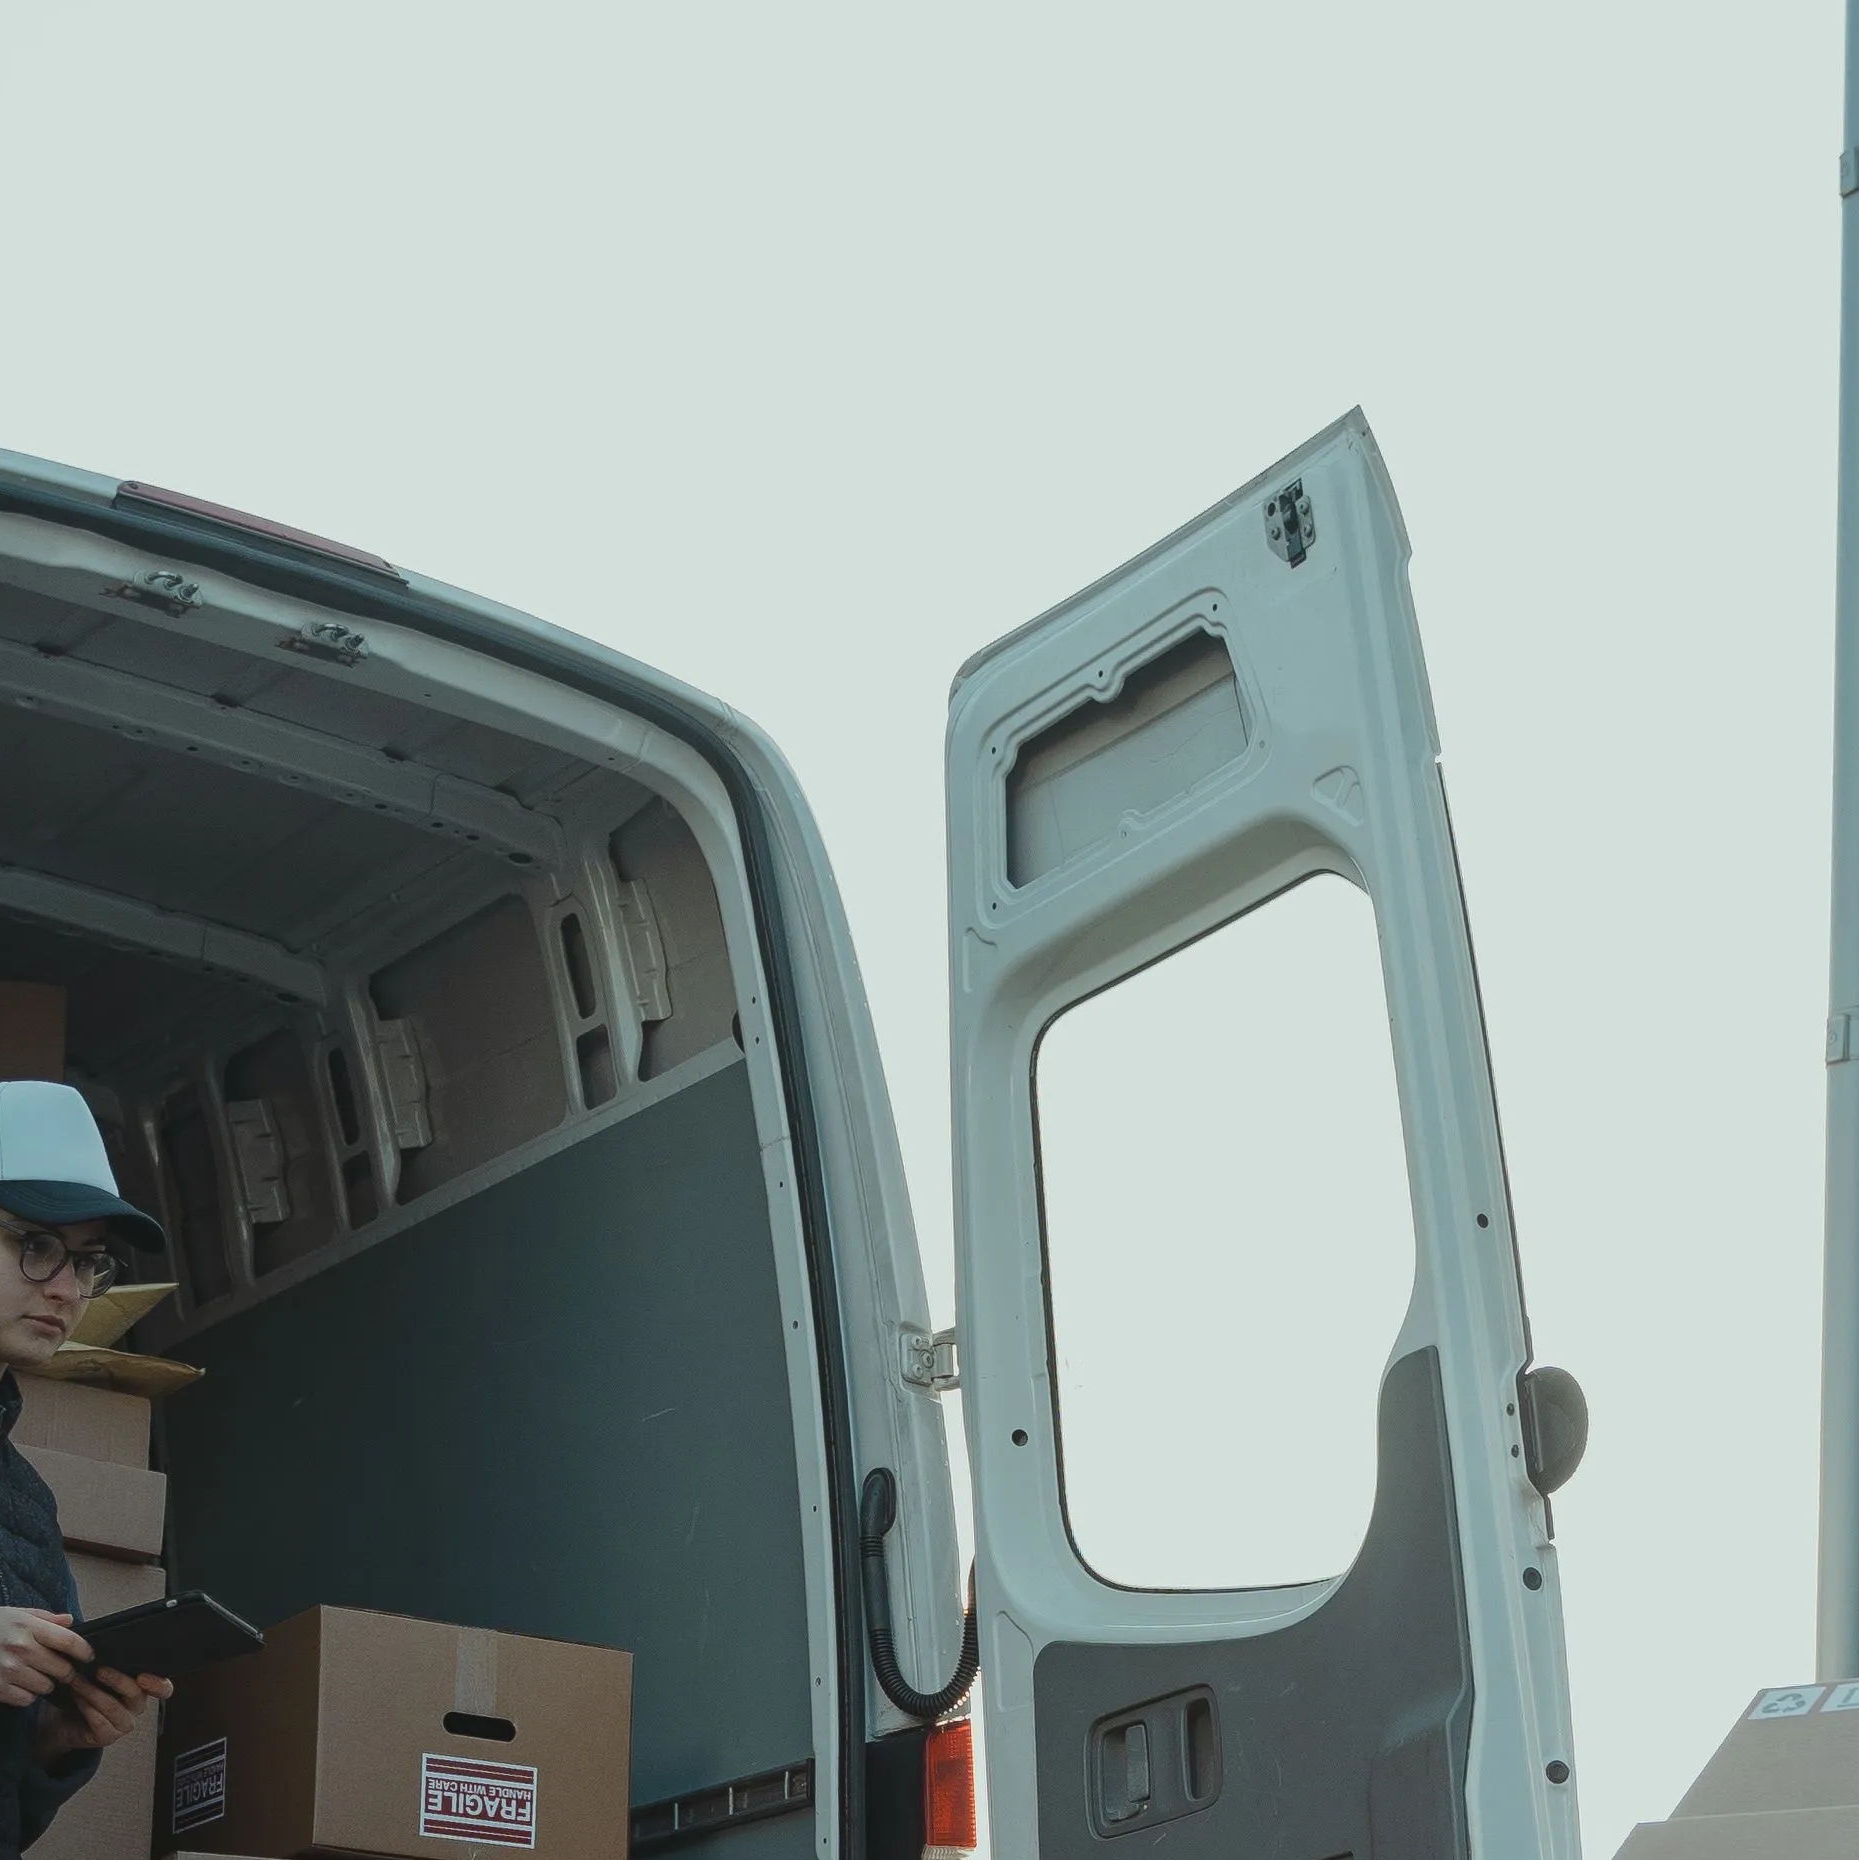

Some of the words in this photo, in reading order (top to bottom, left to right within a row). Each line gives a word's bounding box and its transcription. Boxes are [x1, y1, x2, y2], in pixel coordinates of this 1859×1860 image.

[176, 1772, 223, 1808] FRAGILE
[428, 1778, 458, 1791] CARE
[460, 1783, 487, 1795] WITH
[488, 1786, 532, 1800] HANDLE
[427, 1789, 532, 1822] FRAGILE
